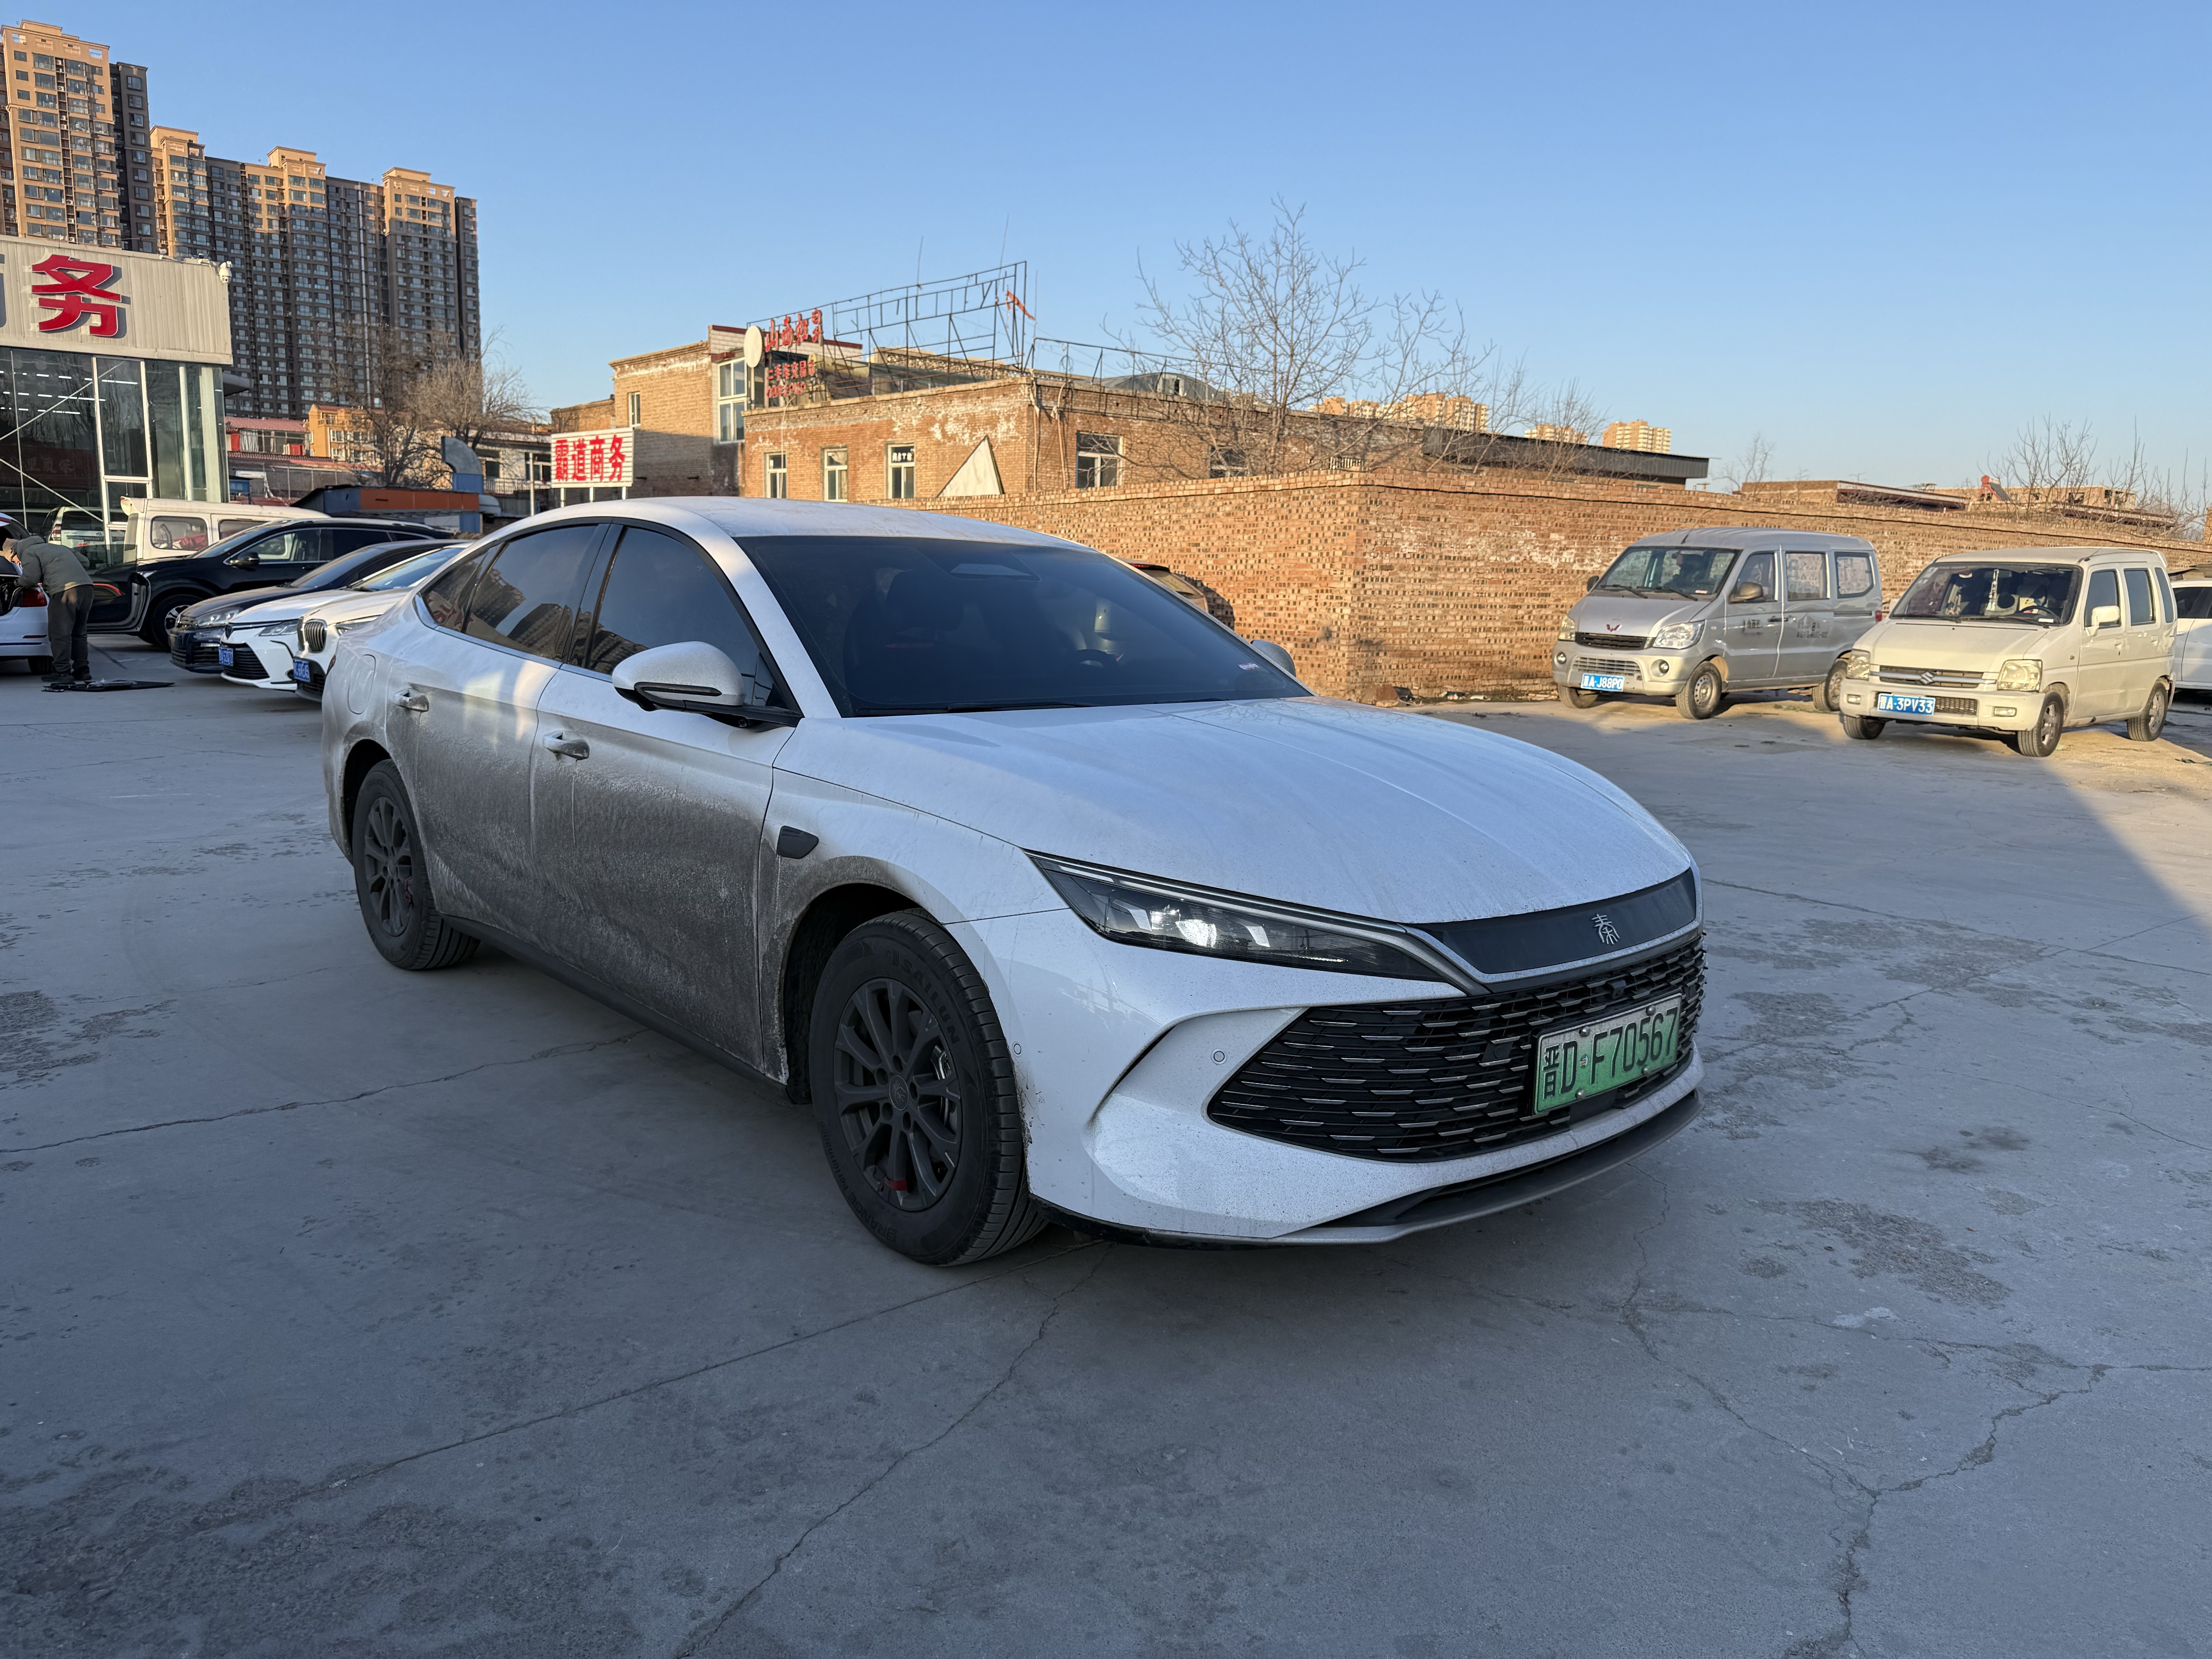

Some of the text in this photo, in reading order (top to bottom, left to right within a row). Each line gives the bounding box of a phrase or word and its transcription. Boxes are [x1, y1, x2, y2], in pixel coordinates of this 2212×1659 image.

[32, 254, 121, 337] 务
[556, 434, 626, 481] 霸道商务
[1591, 914, 1620, 945] 秦
[902, 958, 960, 1044] SAILUN
